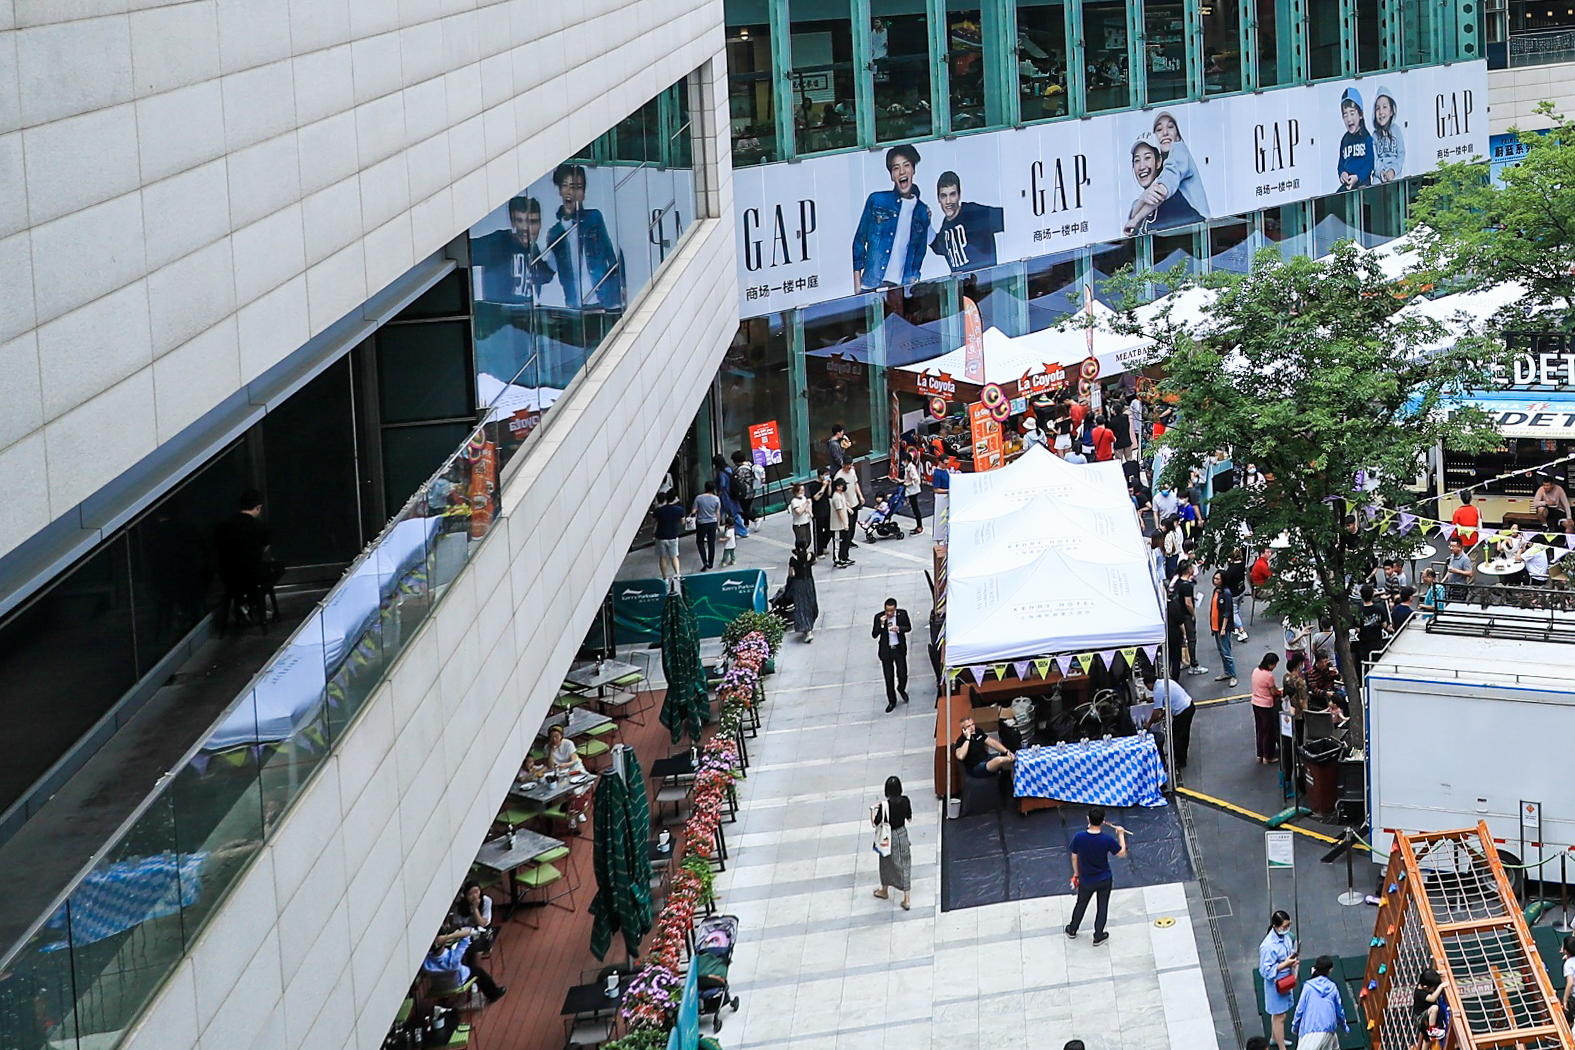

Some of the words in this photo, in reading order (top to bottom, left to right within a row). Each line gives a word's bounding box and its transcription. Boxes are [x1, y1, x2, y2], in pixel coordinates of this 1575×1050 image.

[1436, 89, 1473, 139] GAP
[1254, 118, 1300, 174] GAP
[1436, 143, 1474, 159] 商场一楼中庭
[1031, 154, 1087, 216] GAP
[1255, 178, 1301, 197] 商场一楼中庭
[743, 199, 817, 271] GAP
[1033, 220, 1089, 243] 商场一楼中庭
[944, 223, 969, 268] GAP
[746, 274, 819, 301] 商场一楼中庭
[917, 374, 927, 387] La
[929, 375, 956, 394] Coyota
[1017, 378, 1030, 392] La
[1032, 369, 1066, 389] Coyota
